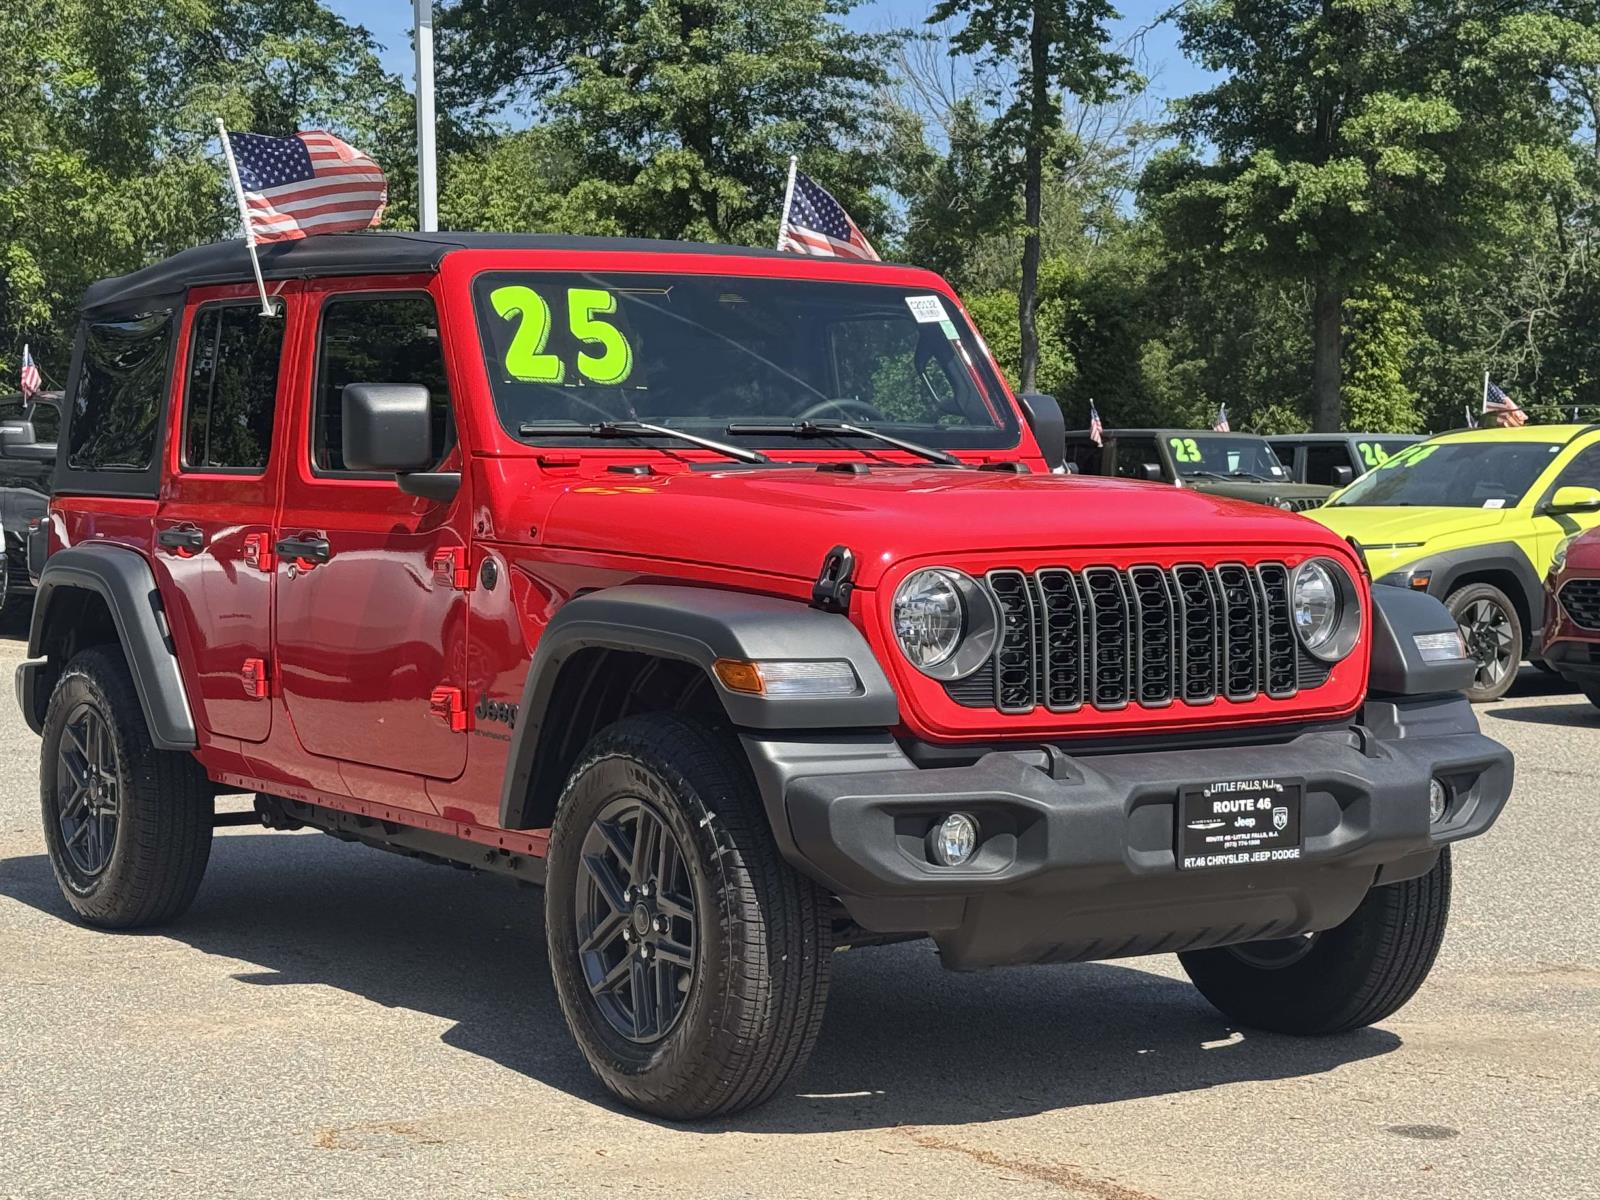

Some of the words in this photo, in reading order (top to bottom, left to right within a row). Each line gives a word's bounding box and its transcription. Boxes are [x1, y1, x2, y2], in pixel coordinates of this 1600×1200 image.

[490, 285, 633, 385] 25
[1170, 438, 1202, 462] 23
[1358, 442, 1390, 466] 26
[475, 688, 520, 730] Jeep
[1211, 782, 1236, 793] LITTLE
[1237, 780, 1261, 790] FALLS,
[1213, 799, 1254, 813] ROUTE
[1256, 797, 1272, 810] 46
[1234, 816, 1256, 828] Jeep
[1206, 853, 1249, 866] CHRYSLER
[1250, 851, 1270, 862] JEEP
[1272, 849, 1300, 860] DODGE
